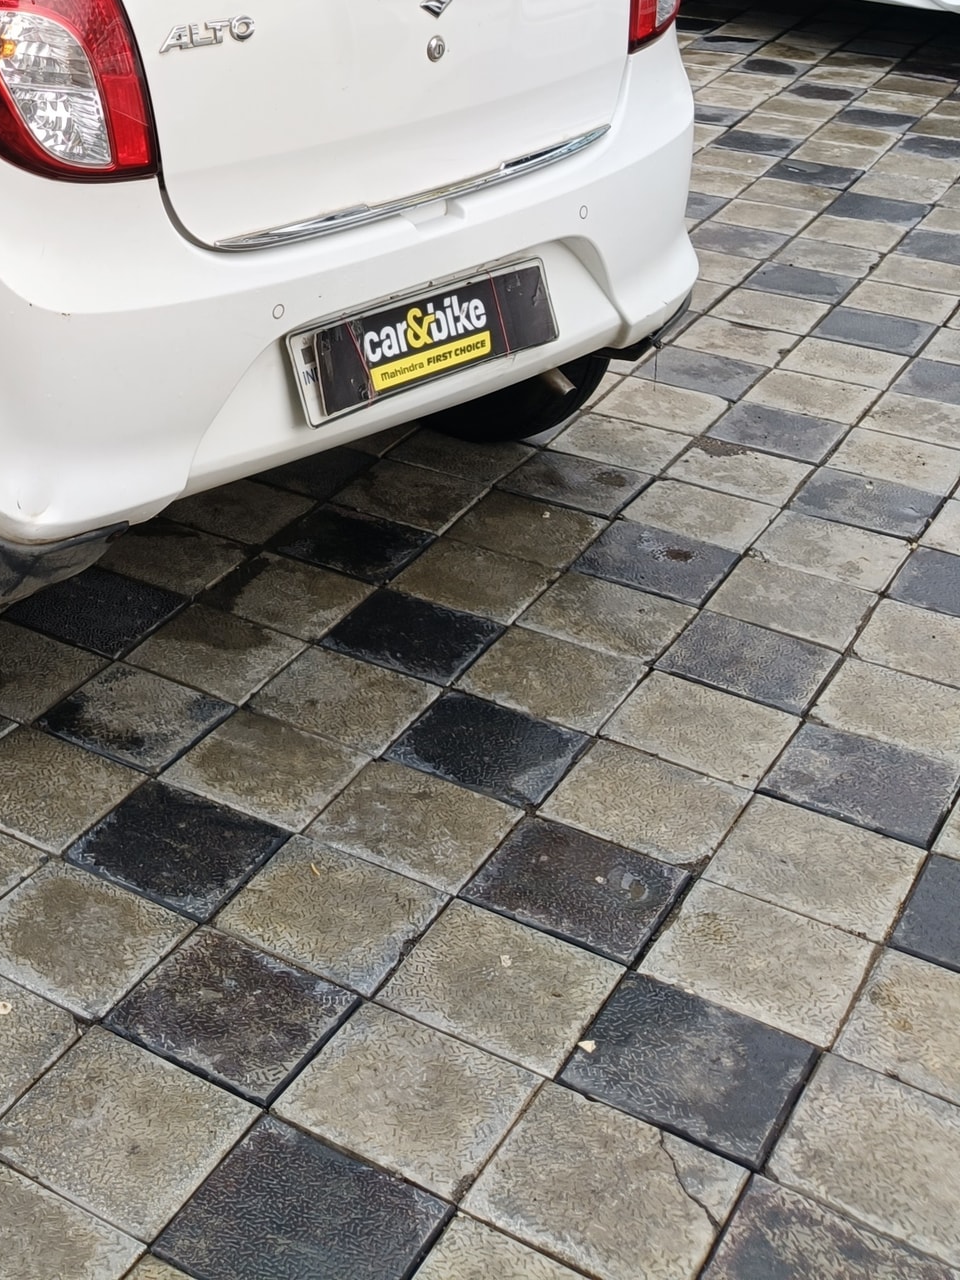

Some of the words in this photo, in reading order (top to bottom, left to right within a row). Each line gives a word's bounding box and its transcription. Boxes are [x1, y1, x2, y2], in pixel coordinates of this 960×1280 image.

[158, 15, 255, 54] ALTO
[363, 295, 487, 362] car&bike
[380, 361, 425, 382] Mahindra
[426, 350, 453, 366] FIRST
[453, 339, 487, 357] CHOICE
